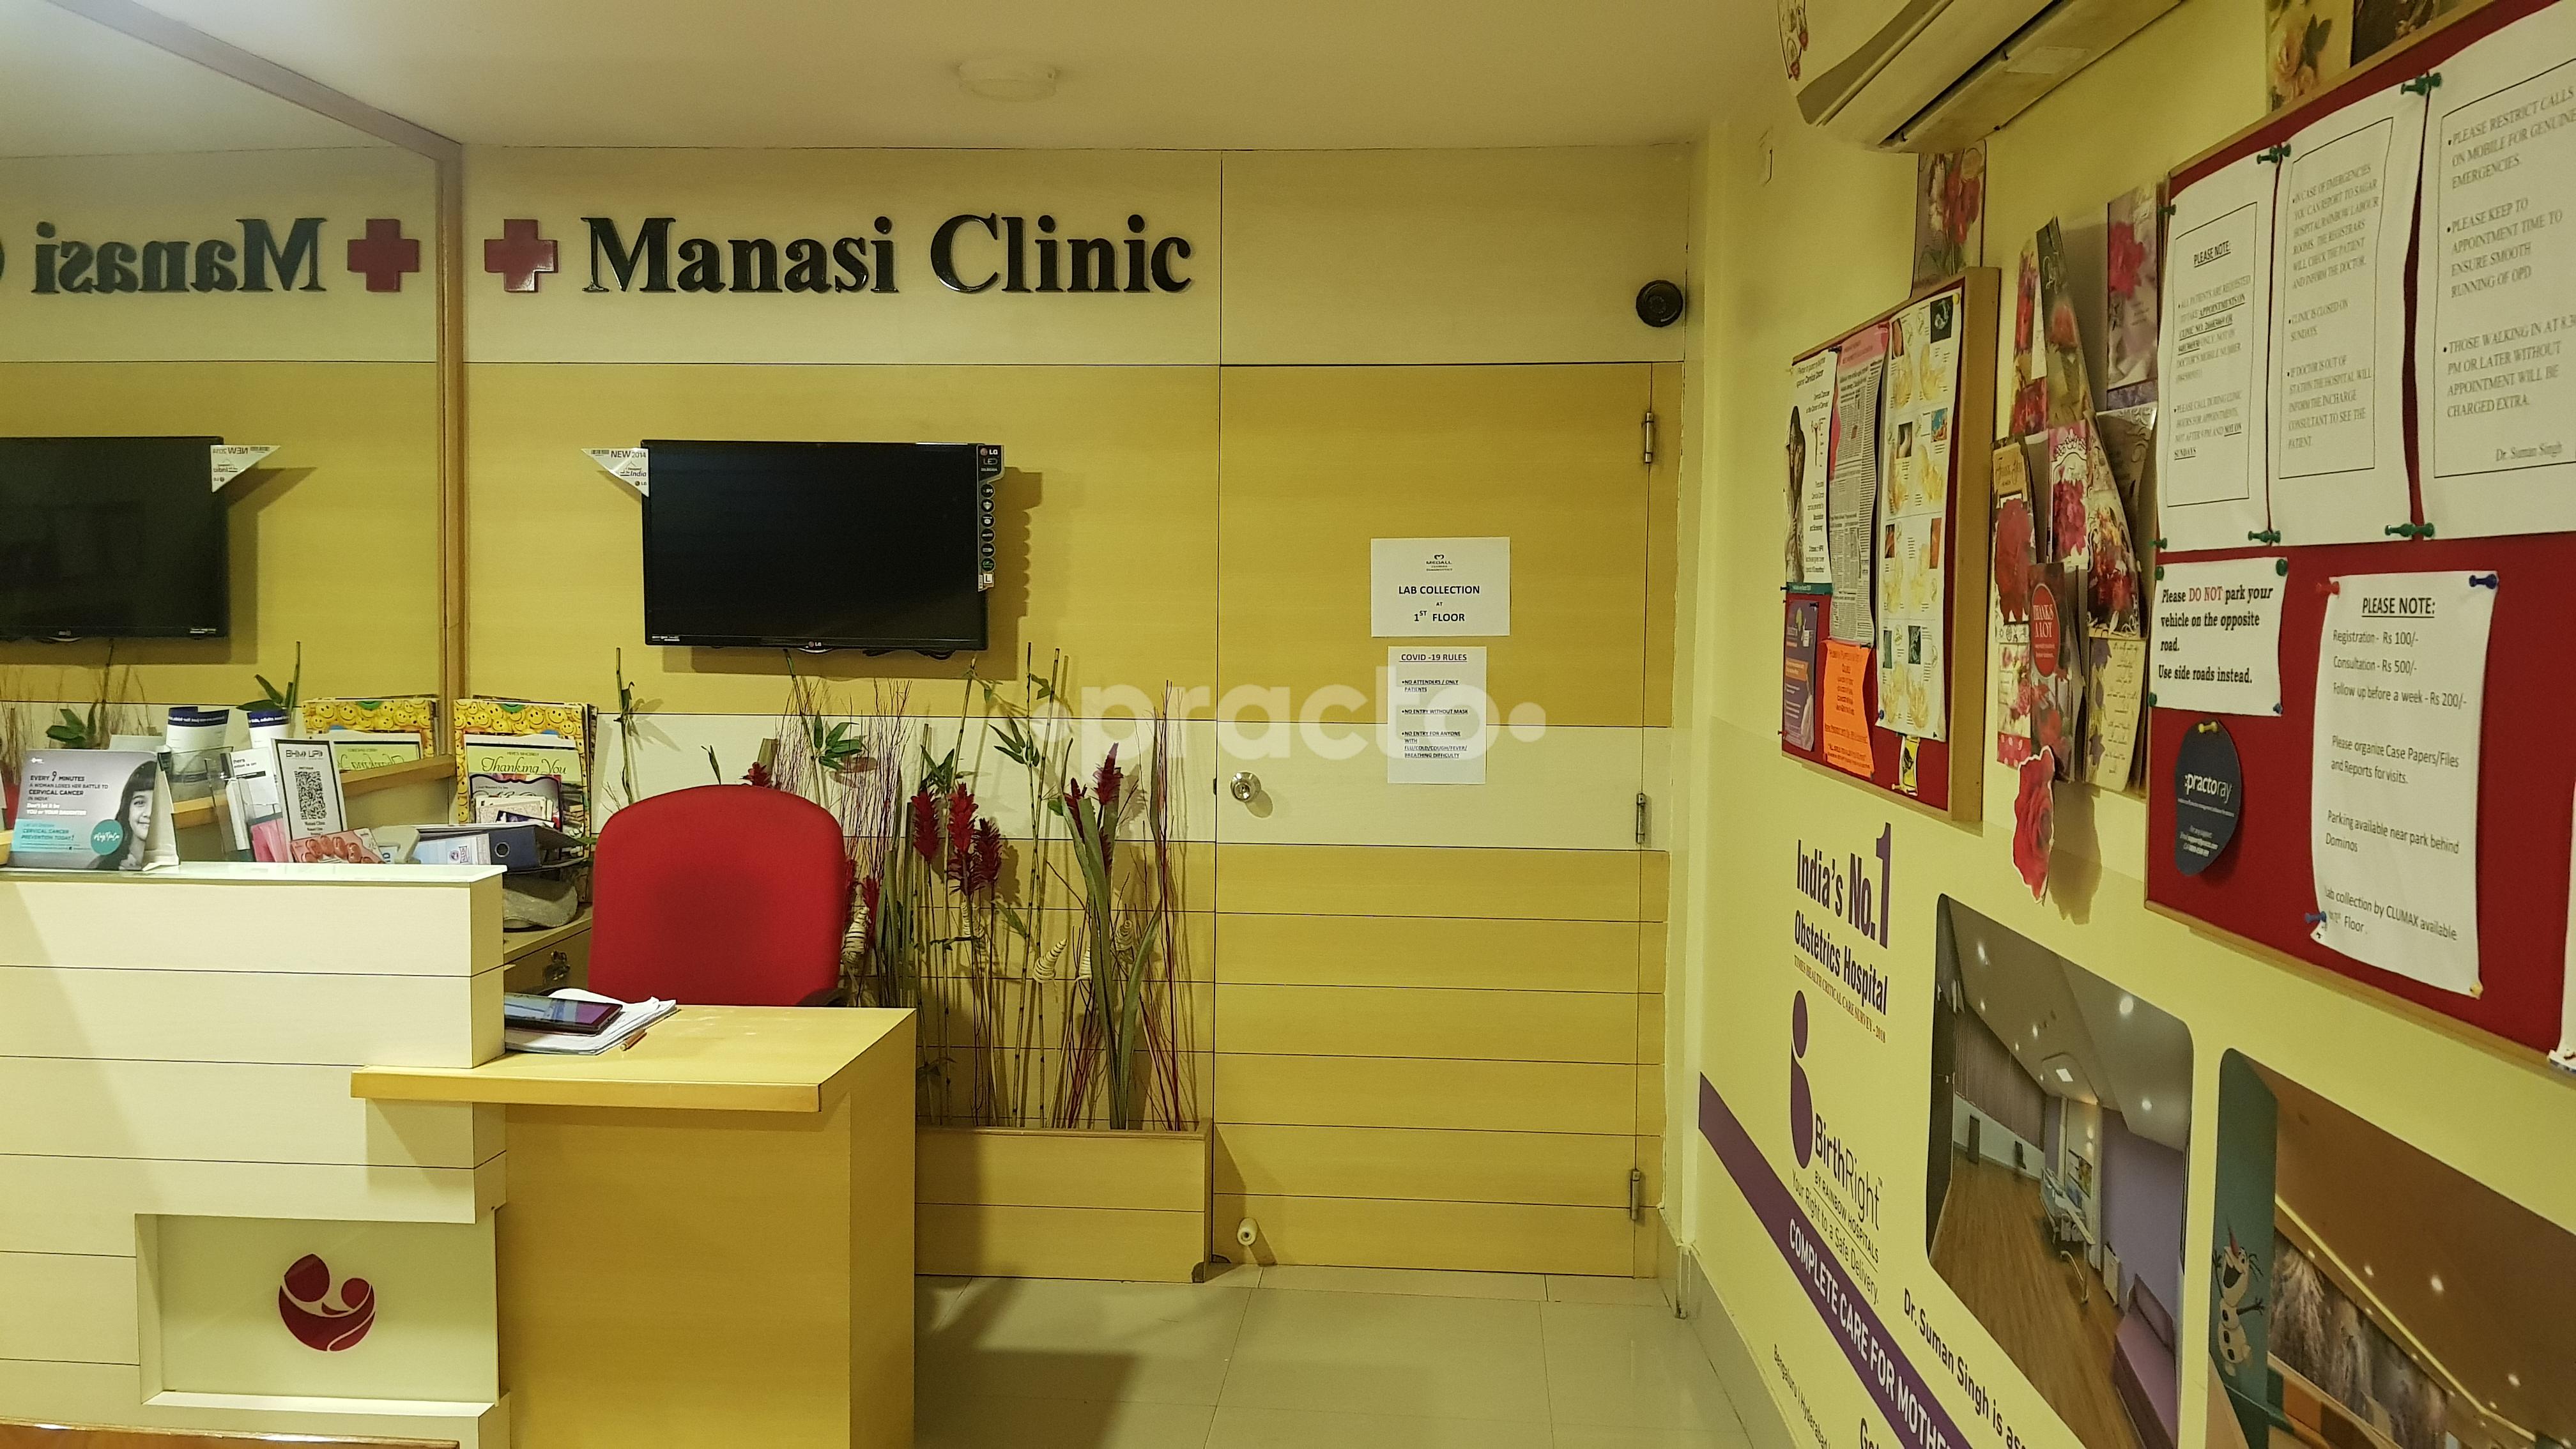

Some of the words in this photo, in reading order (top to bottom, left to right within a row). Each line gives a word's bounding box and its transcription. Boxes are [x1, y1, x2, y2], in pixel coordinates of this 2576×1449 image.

[2453, 121, 2487, 145] PLEASE
[2490, 101, 2538, 131] RESTRICT
[2541, 86, 2574, 109] CALLS
[2452, 155, 2464, 167] ON
[2468, 137, 2505, 158] MOBILE
[2508, 128, 2528, 146] FOR
[2452, 211, 2487, 233] PLEASE
[2488, 203, 2513, 221] KEEP
[2515, 198, 2528, 212] TO
[2453, 223, 2519, 254] APPOINTMENT
[2521, 215, 2546, 233] TIME
[2549, 209, 2563, 224] TO
[581, 216, 898, 294] Manasi
[930, 212, 1193, 295] Clinic
[2194, 247, 2213, 264] PLEASE
[2451, 255, 2488, 276] ENSURE
[2490, 241, 2532, 265] SMOOTH
[2451, 276, 2495, 298] RUNNING
[2497, 271, 2510, 285] OF
[2449, 336, 2481, 353] THOSE
[2482, 326, 2529, 346] WALKING
[2531, 322, 2542, 336] IN
[2545, 318, 2558, 334] AT
[2448, 362, 2461, 375] PM
[2464, 358, 2477, 372] OR
[2480, 351, 2511, 369] LATER
[2513, 340, 2561, 361] WITHOUT
[2448, 372, 2515, 397] APPOINTMENT
[2517, 369, 2542, 383] WILL
[2546, 364, 2559, 379] BE
[2448, 399, 2495, 418] CHARGED
[1399, 586, 1417, 594] LAB
[2162, 589, 2186, 602] Please
[2189, 587, 2202, 602] DO
[2204, 586, 2223, 601] NOT
[2225, 585, 2245, 604] park
[2248, 588, 2273, 604] your
[2362, 597, 2395, 614] PLEASE
[2399, 597, 2435, 615] NOTE:
[1414, 611, 1427, 622] 1ST
[2161, 613, 2189, 627] vehicle
[2192, 616, 2201, 627] on
[2204, 612, 2218, 627] the
[2221, 611, 2260, 631] opposite
[2160, 637, 2180, 651] road.
[2383, 632, 2392, 644] Rs
[2395, 631, 2418, 647] 100/-
[2159, 664, 2172, 678] Use
[2174, 665, 2189, 680] side
[2193, 666, 2214, 681] roads
[2217, 666, 2252, 684] instead.
[2333, 656, 2375, 671] Consultation
[2382, 659, 2391, 672] Rs
[2395, 660, 2417, 676] 500/-
[2333, 682, 2355, 697] Follow
[2357, 688, 2366, 700] up
[2367, 686, 2391, 701] before
[2393, 692, 2398, 702] a
[2402, 690, 2423, 703] week
[2430, 692, 2440, 705] Rs
[2442, 693, 2467, 710] 200/-
[482, 756, 539, 774] Thanking
[541, 759, 566, 774] You
[2332, 735, 2352, 750] Please
[2354, 741, 2384, 755] organize
[2386, 745, 2405, 759] Case
[2408, 747, 2459, 767] Papers/Files
[52, 771, 57, 781] 9
[2331, 760, 2343, 770] and
[2345, 761, 2372, 777] Reports
[2374, 766, 2384, 779] for
[2386, 769, 2409, 783] visits.
[2326, 833, 2358, 852] Dominos
[2327, 809, 2353, 830] Parking
[2356, 820, 2388, 837] available
[2390, 828, 2408, 841] near
[2410, 832, 2428, 846] park
[2430, 834, 2459, 854] behind
[1797, 839, 1843, 917] India's
[2336, 893, 2372, 912] collection
[2373, 901, 2384, 918] by
[2386, 905, 2418, 927] CLUMAX
[2420, 920, 2457, 940] available
[1795, 910, 1840, 977] Obstetrics
[1844, 945, 1888, 1015] Hospital
[1795, 954, 1806, 974] TIMES
[1806, 965, 1821, 988] HEALTH
[1822, 979, 1841, 1006] CRITICAL
[1843, 996, 1854, 1016] CARE
[1855, 1006, 1873, 1032] SURVEY
[1876, 1025, 1885, 1043] 2018
[1816, 1113, 1879, 1230] BirthRight
[1815, 1170, 1821, 1188] BY
[1822, 1180, 1846, 1222] RAINBOW
[1848, 1213, 1879, 1264] HOSPITALS
[1792, 1169, 1804, 1199] Your
[1805, 1187, 1820, 1222] Right
[1822, 1209, 1827, 1232] to
[1829, 1224, 1833, 1240] a
[1836, 1227, 1848, 1262] Safe
[1851, 1248, 1879, 1305] Delivery.
[1790, 1218, 1839, 1315] COMPLETE
[1840, 1292, 1869, 1361] CARE
[1870, 1336, 1896, 1402] FOR
[1897, 1376, 1951, 1449] MOTHE
[1774, 1344, 1797, 1397] Bengaluru
[1905, 1287, 1917, 1326] Dr.
[1919, 1308, 1954, 1374] Suman
[1958, 1356, 1989, 1420] Singh
[1993, 1399, 2002, 1437] is
